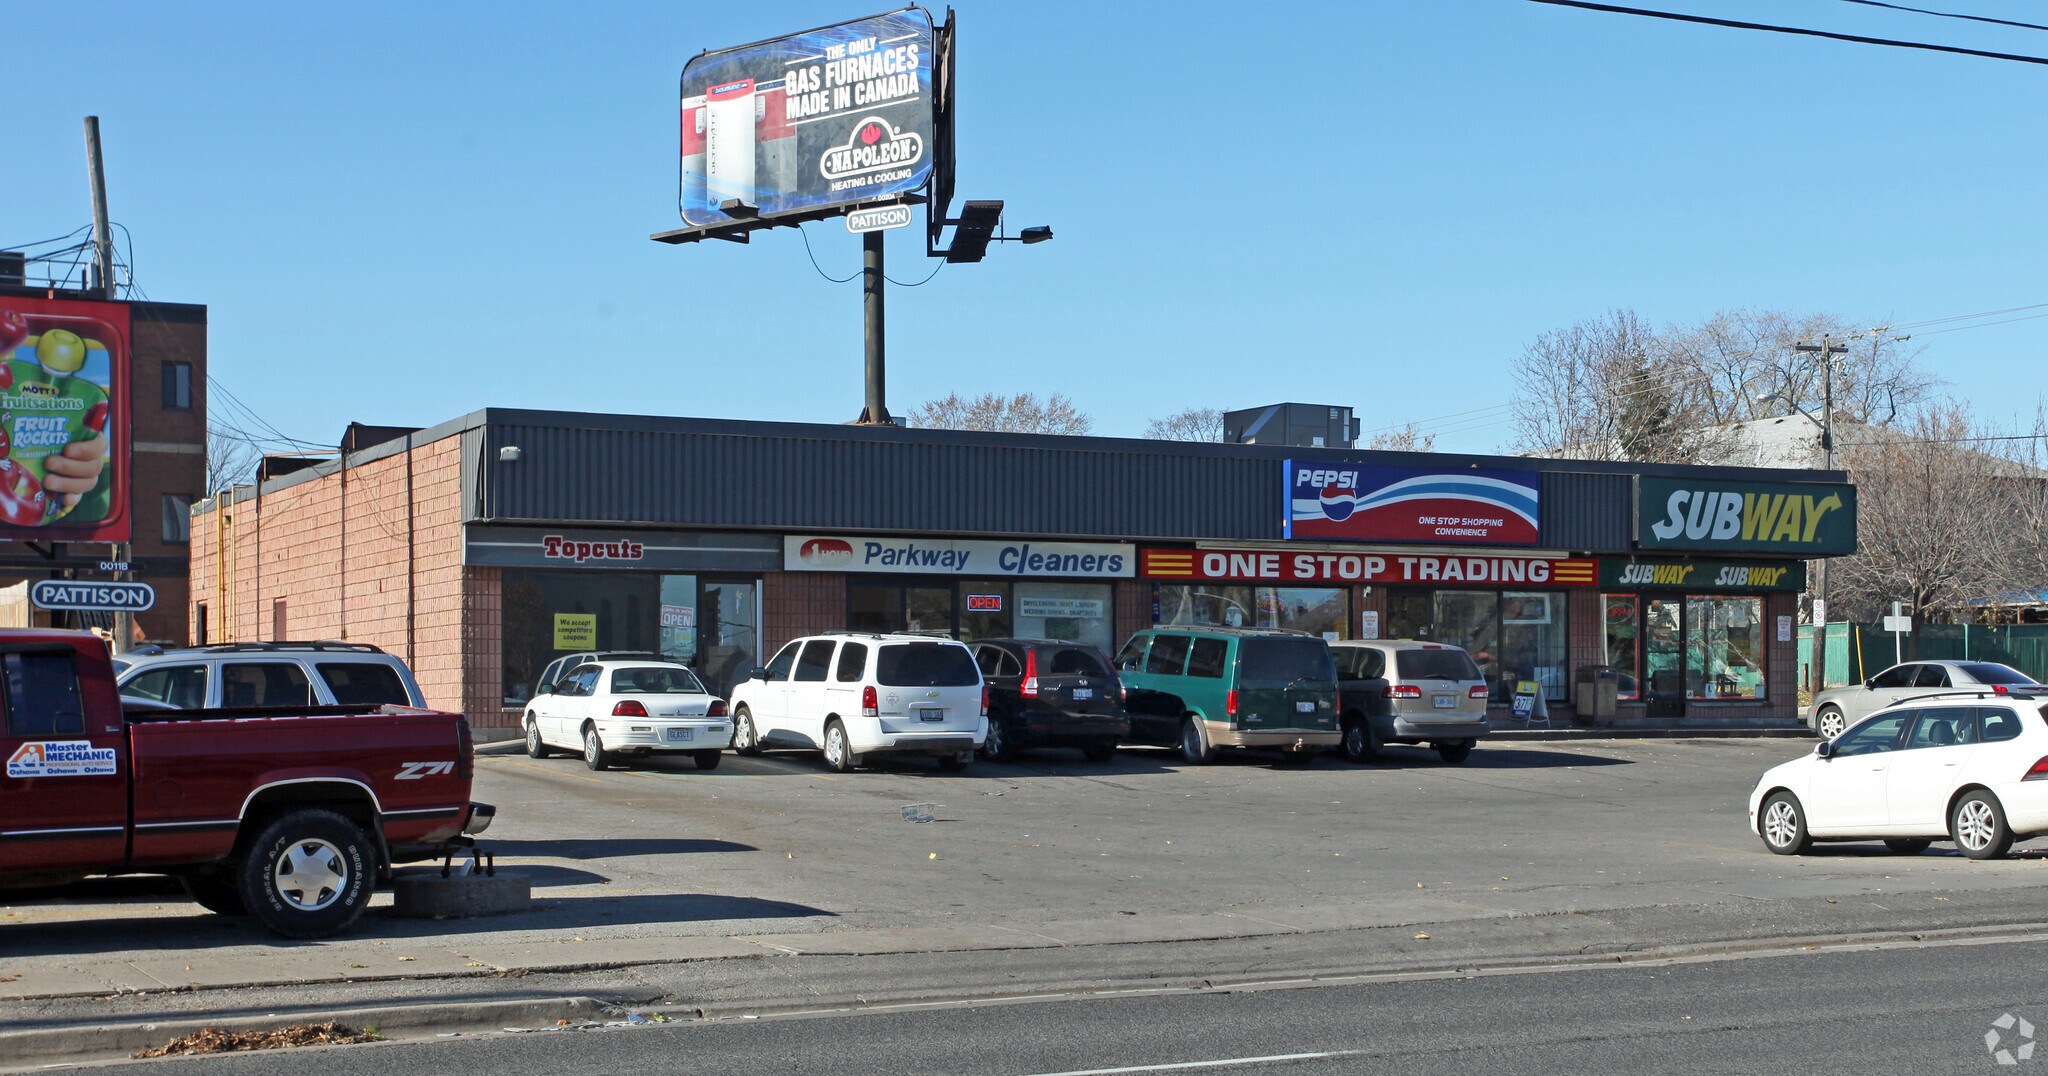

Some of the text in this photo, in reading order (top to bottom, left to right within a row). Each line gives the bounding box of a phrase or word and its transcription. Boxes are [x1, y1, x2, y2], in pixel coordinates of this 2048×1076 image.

[826, 37, 876, 60] THE ONLY
[785, 44, 919, 96] GAS FURNACES
[786, 72, 919, 119] MADE IN CANADA
[832, 139, 911, 173] NAPOLEON
[832, 169, 912, 191] HEATING & COOLING
[851, 210, 907, 229] PATTISON
[14, 416, 66, 432] FRUIT
[13, 431, 69, 448] ROCKETS
[1296, 469, 1358, 489] PEPSI
[1418, 516, 1503, 527] ONE STOP SHOPPING
[1651, 489, 1843, 543] SUBWAY
[1435, 527, 1488, 537] CONVENIENCE
[543, 535, 643, 562] Topcuts
[864, 541, 1124, 574] Parkway Cleaners
[100, 561, 128, 571] 0011B
[1203, 552, 1549, 583] ONE STOP TRADING
[1619, 564, 1694, 585] SUBWAY
[1715, 566, 1787, 587] SUBWAY
[42, 586, 144, 605] PATTISON
[969, 597, 1000, 609] OPEN
[663, 613, 691, 627] OPEN
[45, 743, 89, 752] Master
[46, 751, 114, 761] MECHANIC
[394, 761, 455, 780] Z71
